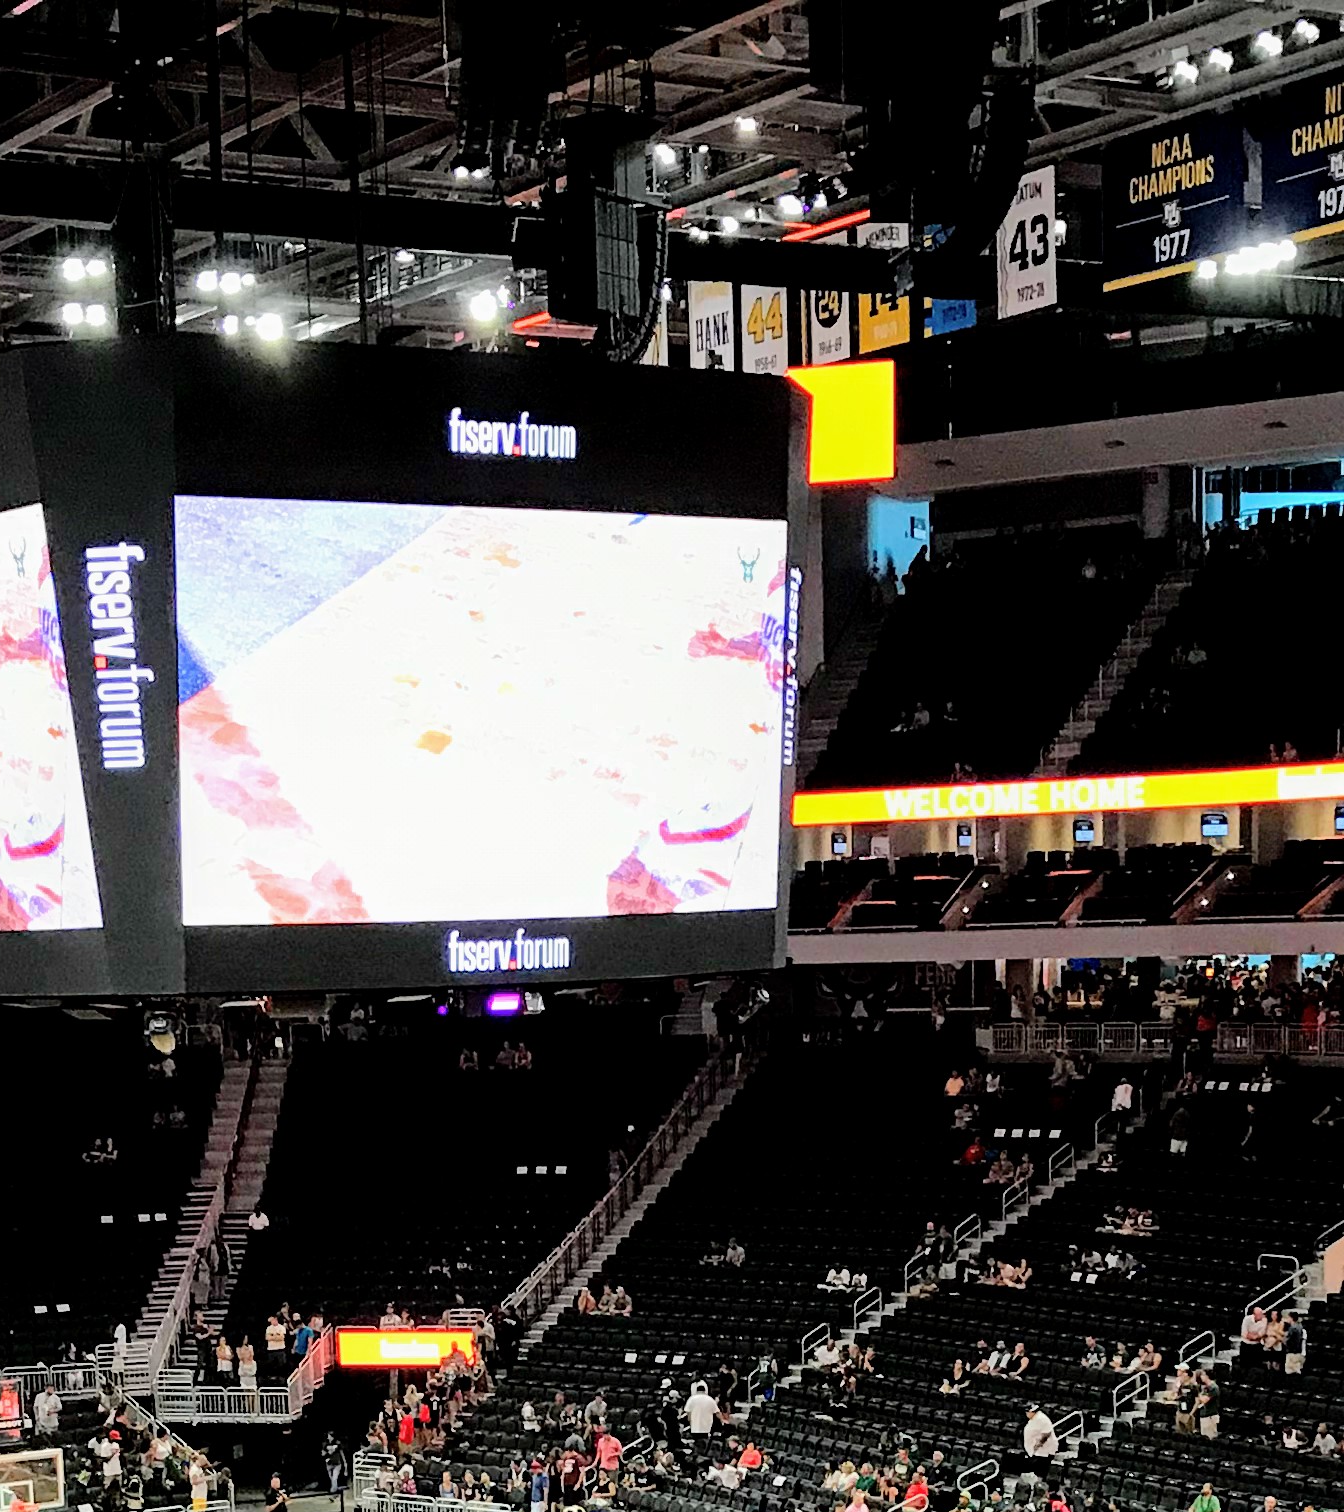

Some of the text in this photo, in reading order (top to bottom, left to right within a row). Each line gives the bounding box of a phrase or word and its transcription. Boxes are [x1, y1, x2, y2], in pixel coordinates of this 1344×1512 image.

[1151, 133, 1193, 169] NCAA
[1016, 182, 1042, 205] ATUM
[1129, 155, 1215, 204] CHAMPIONS
[1009, 213, 1049, 271] 43
[1153, 229, 1191, 263] 1977
[696, 310, 729, 352] HANK
[747, 291, 783, 344] 44
[449, 407, 576, 458] fiserv.forum
[86, 541, 155, 768] fiserv.forum
[884, 777, 1145, 818] WELCOME HOME
[449, 928, 570, 972] fiserv.forum
